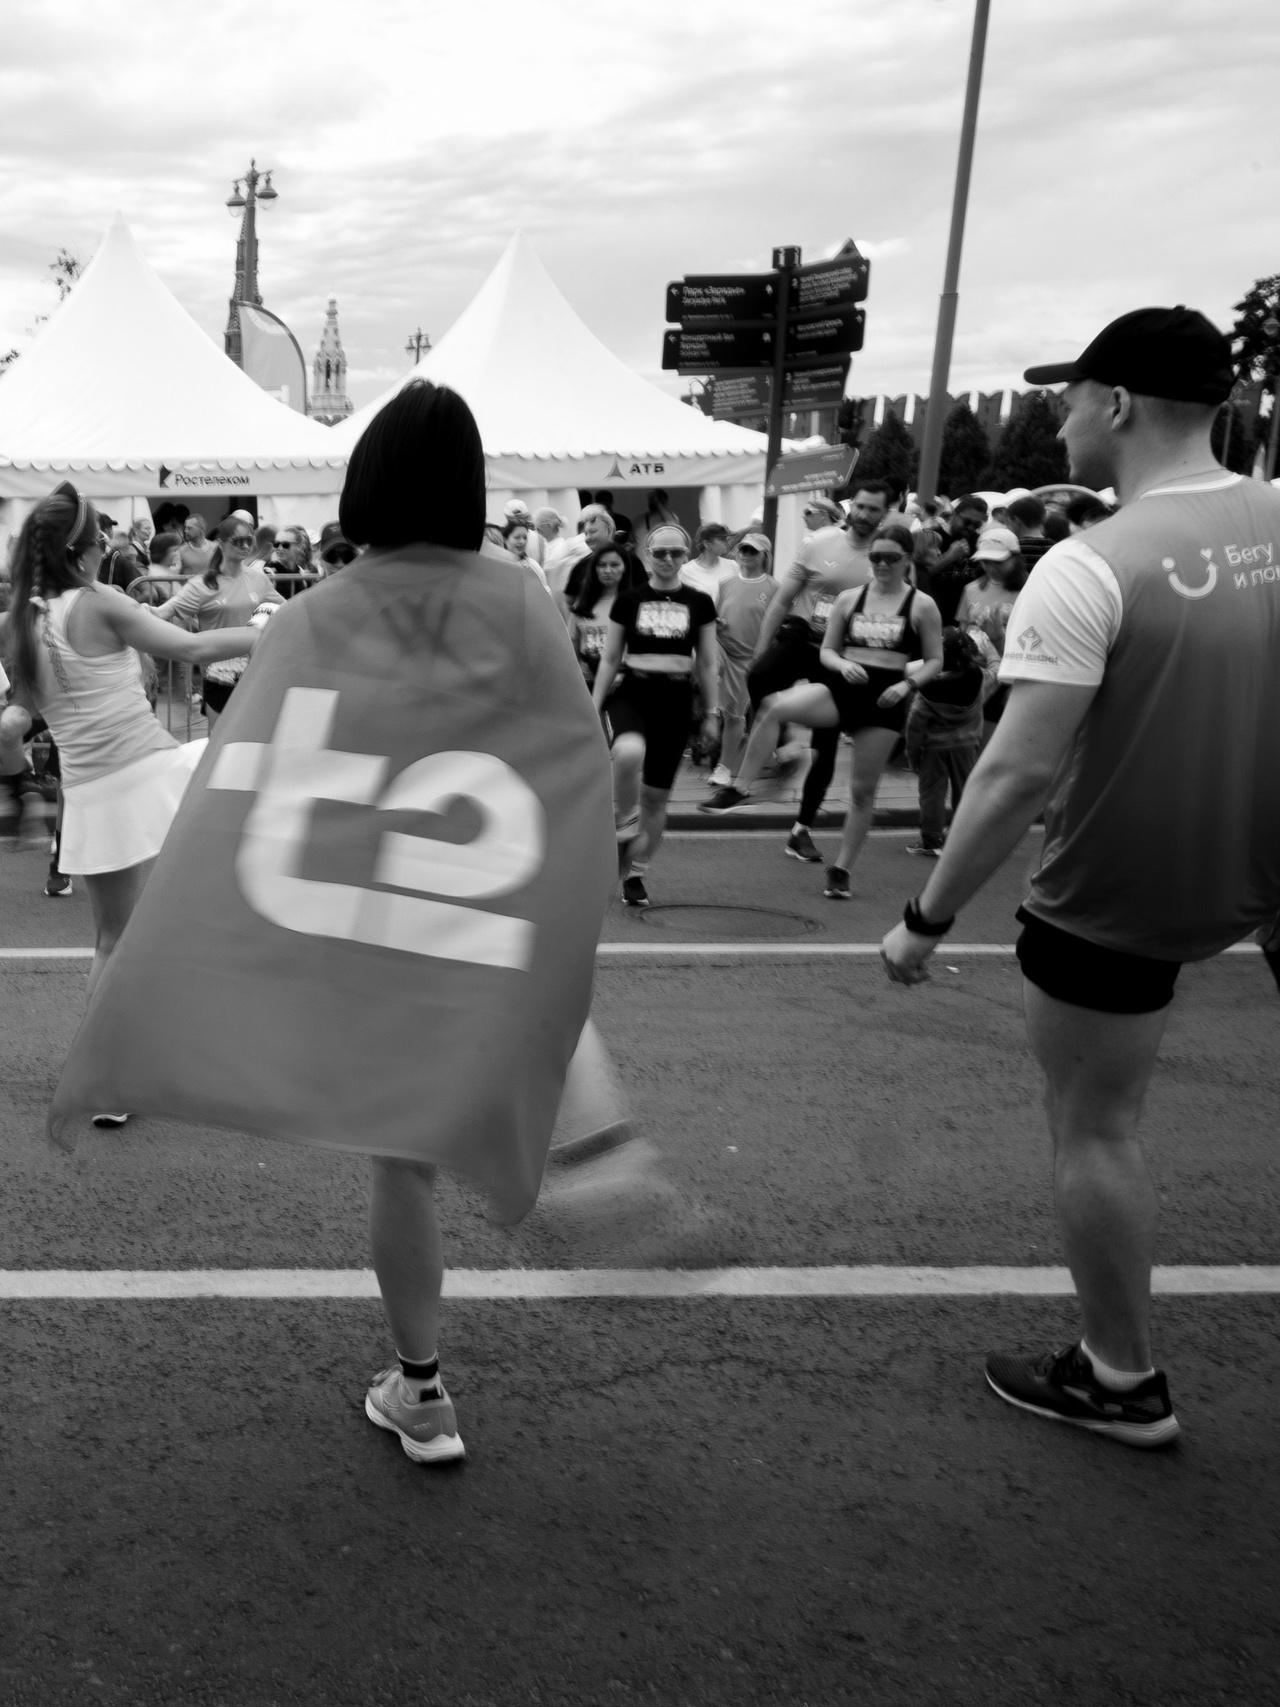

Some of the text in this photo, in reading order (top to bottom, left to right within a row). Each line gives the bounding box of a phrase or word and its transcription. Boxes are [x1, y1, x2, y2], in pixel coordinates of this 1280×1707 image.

[629, 462, 665, 475] АТБ
[174, 473, 250, 486] Ростелеком
[1223, 543, 1273, 566] Бегу
[1233, 572, 1248, 590] и
[206, 686, 547, 973] t2
